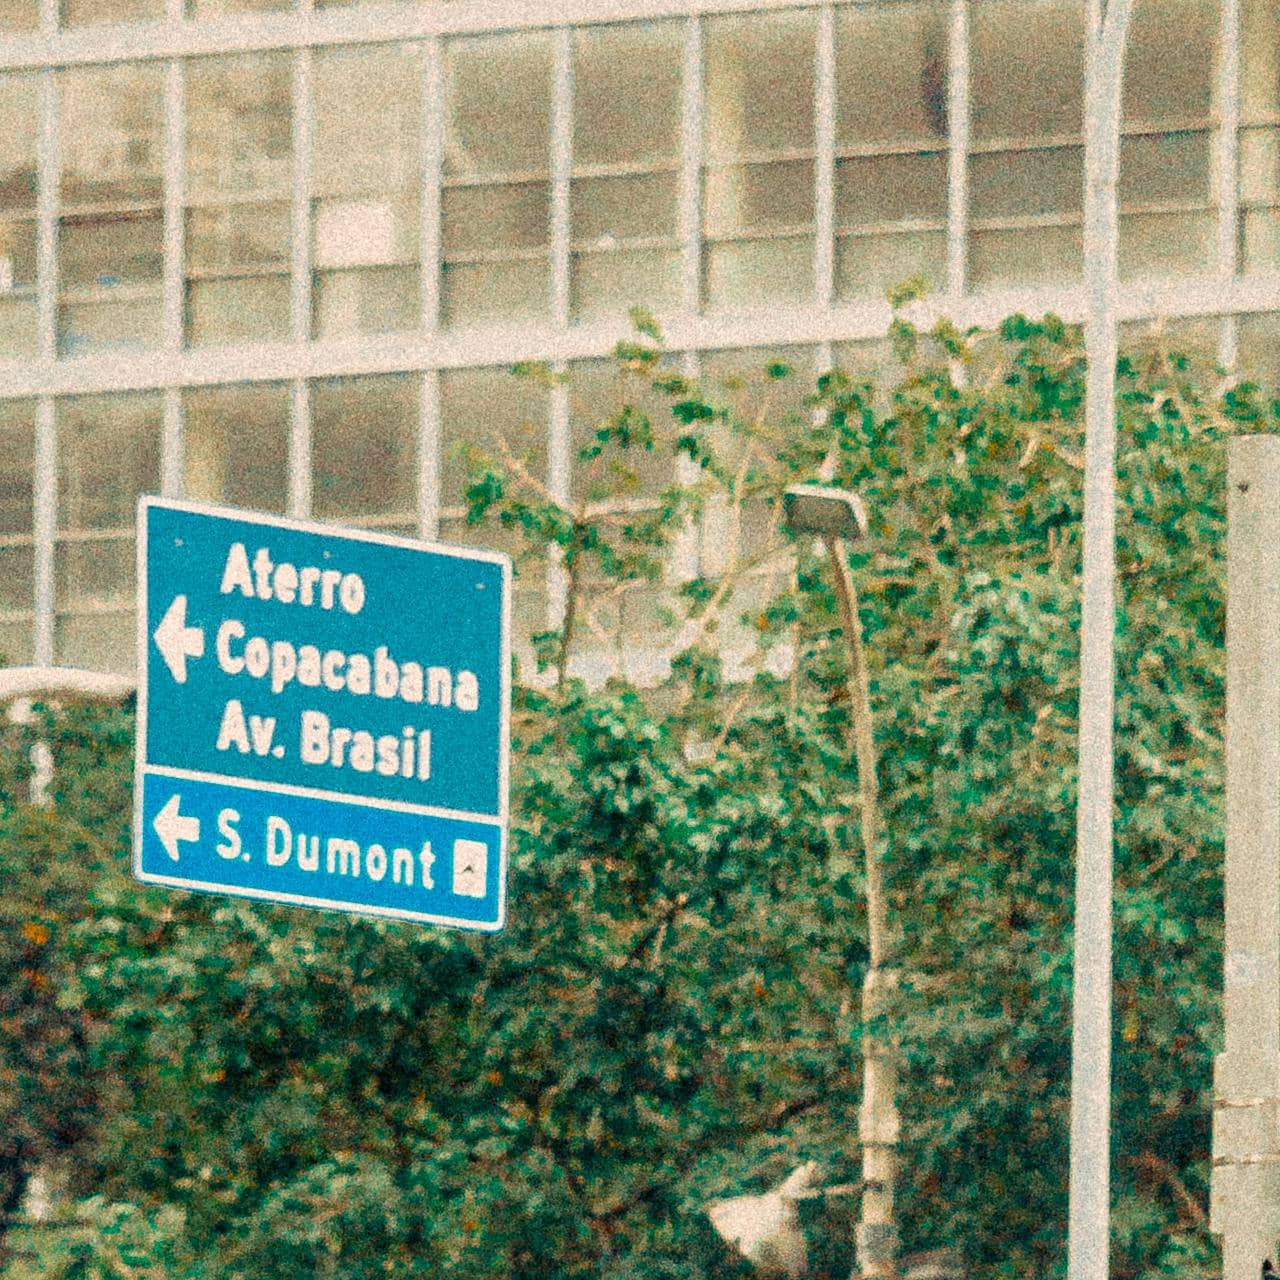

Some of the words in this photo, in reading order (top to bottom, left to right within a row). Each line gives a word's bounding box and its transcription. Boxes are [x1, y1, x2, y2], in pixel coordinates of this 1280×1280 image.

[221, 542, 365, 614] Aterro
[216, 619, 480, 712] Copacabana
[216, 700, 285, 759] Av.
[301, 710, 431, 781] Brasil
[216, 808, 250, 862] S.
[266, 815, 436, 890] Dumont
